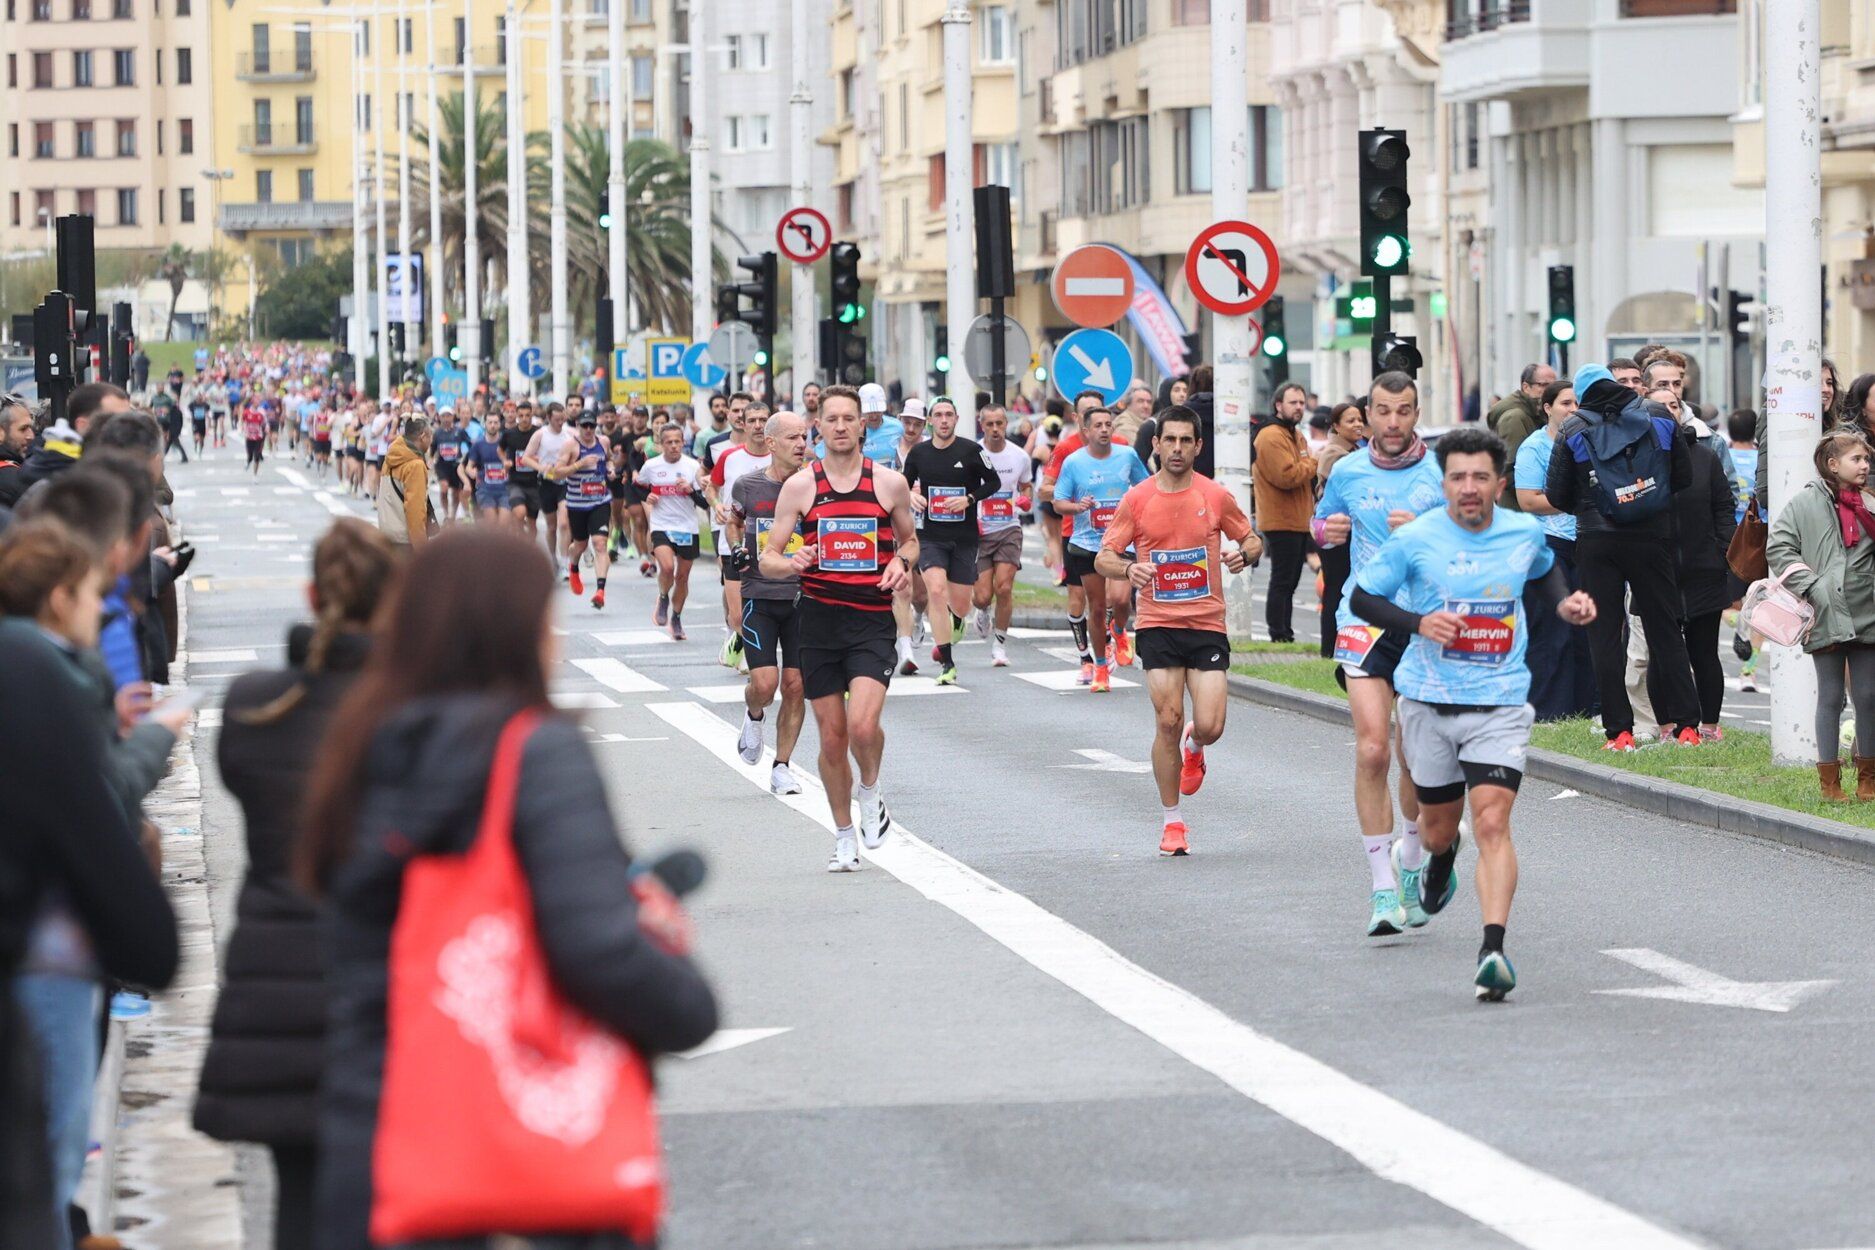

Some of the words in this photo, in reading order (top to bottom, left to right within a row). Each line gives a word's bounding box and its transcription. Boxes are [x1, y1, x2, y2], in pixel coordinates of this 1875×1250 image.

[833, 541, 866, 550] DAVID
[840, 552, 857, 560] 2134
[1169, 552, 1198, 562] ZURICH
[1163, 569, 1202, 581] GAIZKA
[1174, 582, 1189, 590] 1931
[1473, 605, 1508, 614] ZURICH
[1459, 628, 1509, 640] MERVIN
[1473, 643, 1490, 652] 1911
